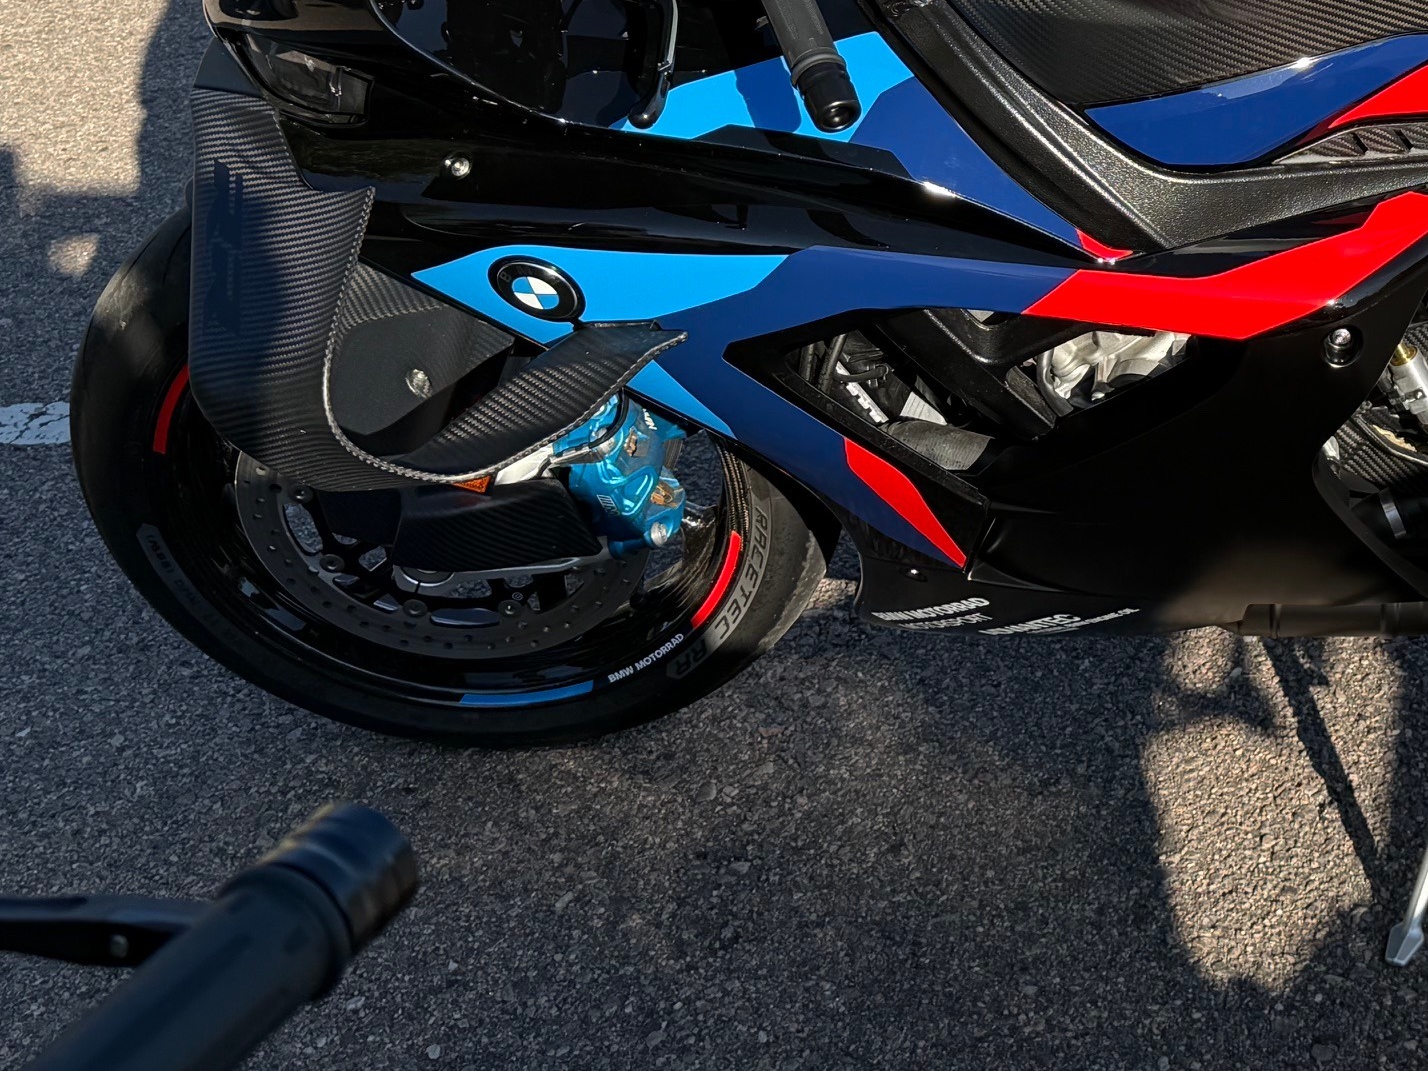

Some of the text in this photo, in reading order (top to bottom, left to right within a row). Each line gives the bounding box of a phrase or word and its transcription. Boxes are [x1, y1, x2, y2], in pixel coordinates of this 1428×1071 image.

[715, 506, 768, 640] RACETEC
[903, 597, 990, 620] MOTORRAD
[608, 633, 684, 683] BMW MOTORRAD
